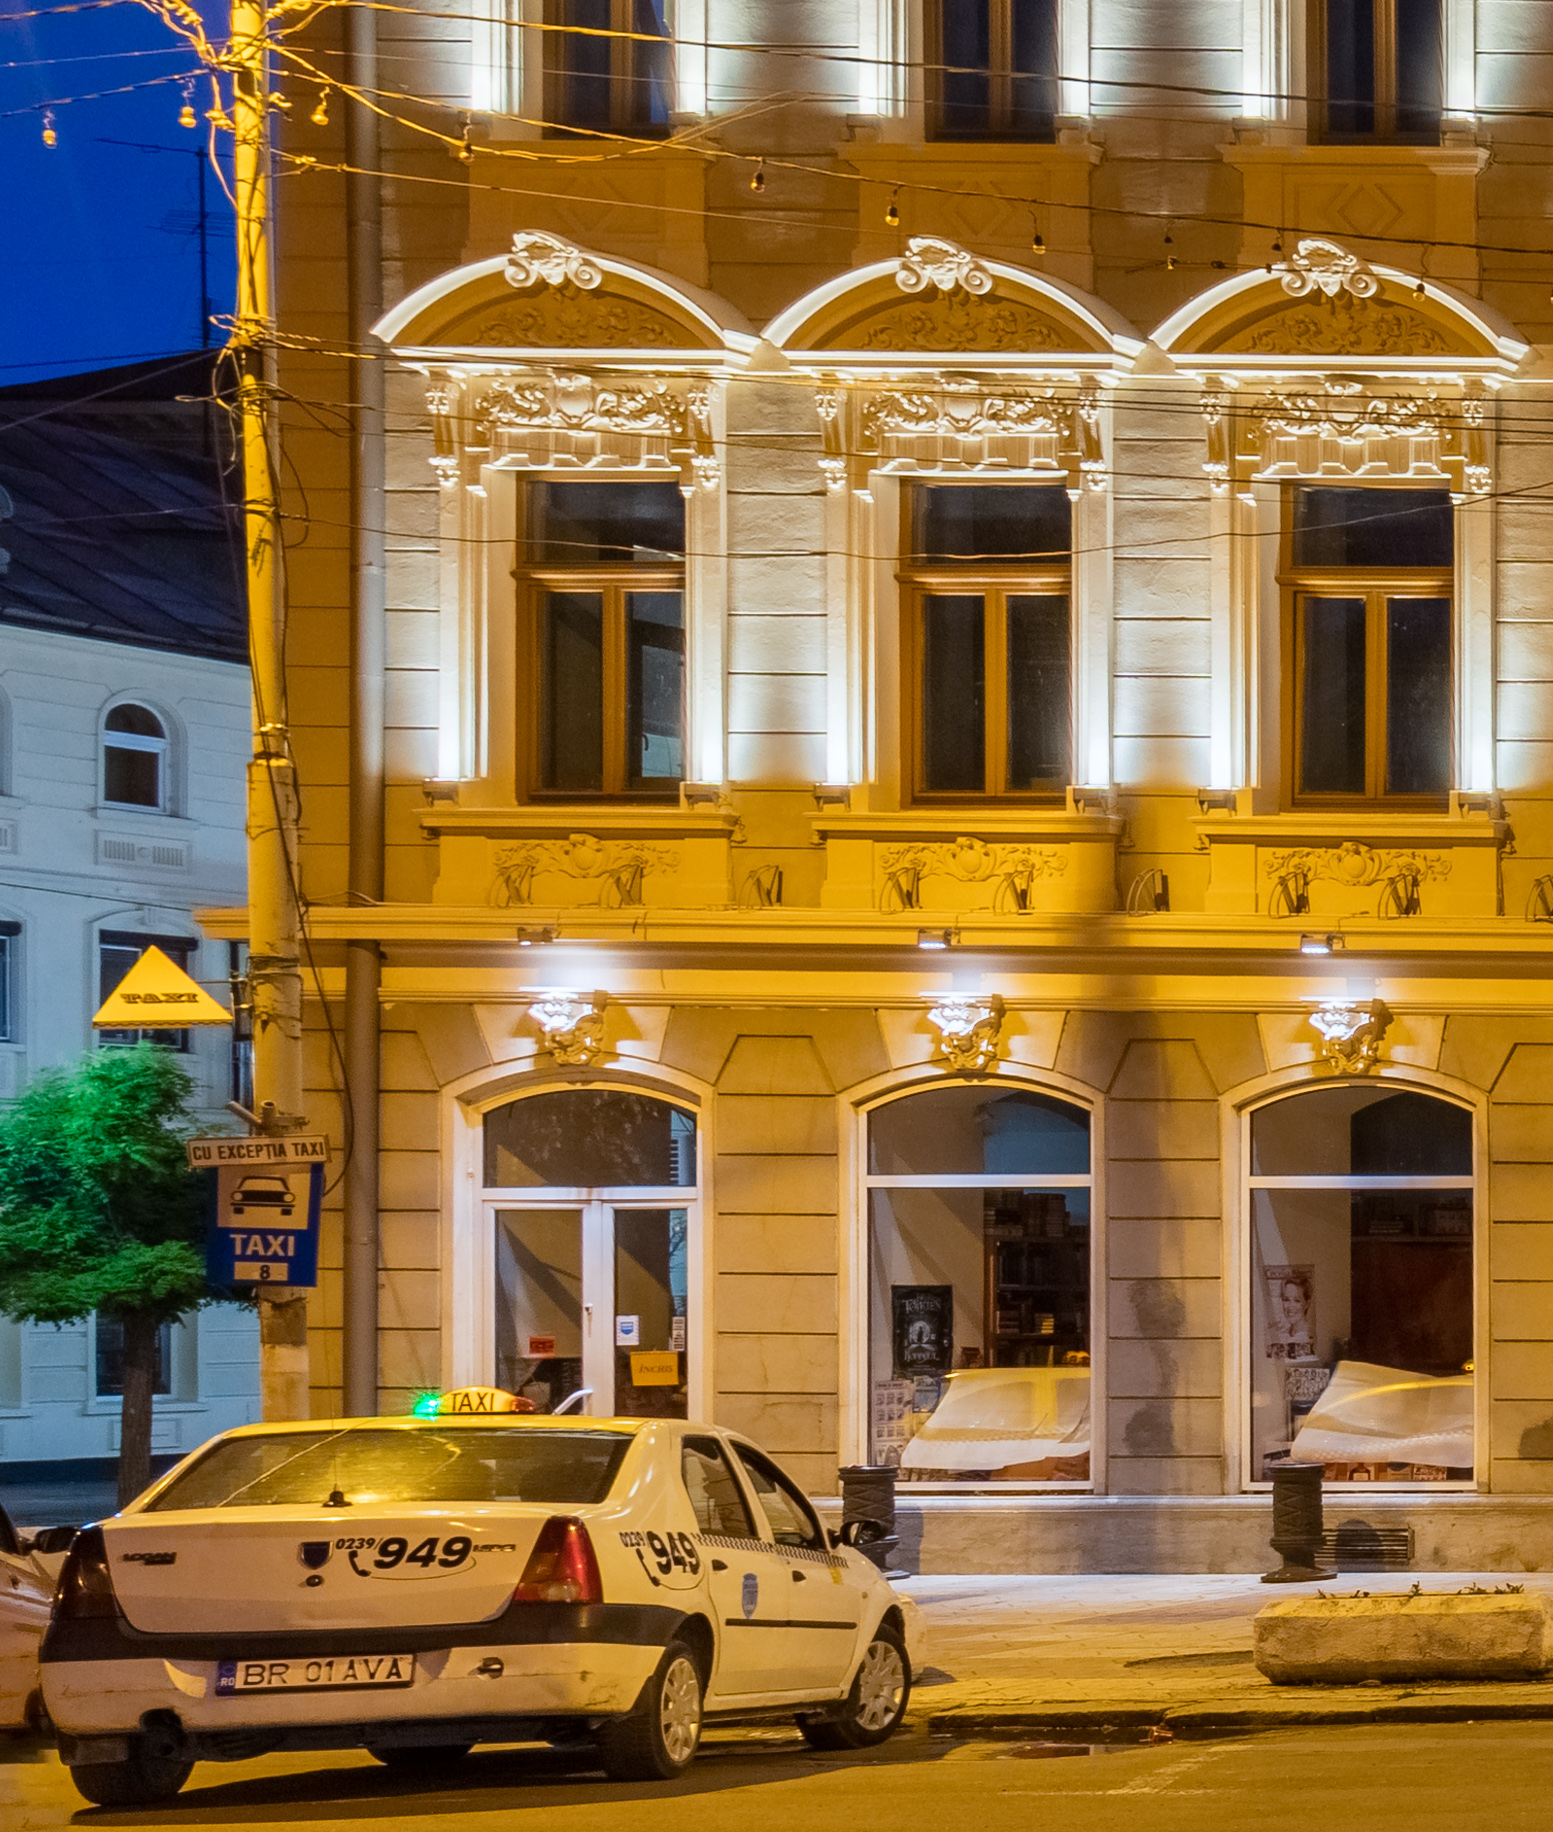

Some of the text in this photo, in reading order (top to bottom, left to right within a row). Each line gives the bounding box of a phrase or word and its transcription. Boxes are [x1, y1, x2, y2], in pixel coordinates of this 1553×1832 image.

[120, 992, 199, 1005] TAXI
[193, 1145, 211, 1161] CU
[292, 1141, 325, 1158] TAXI
[229, 1234, 295, 1257] TAXI
[259, 1264, 271, 1280] 8
[451, 1392, 495, 1412] TAXI
[373, 1536, 472, 1569] 949
[646, 1530, 701, 1575] 949
[220, 1676, 235, 1686] RO
[242, 1663, 290, 1686] BR
